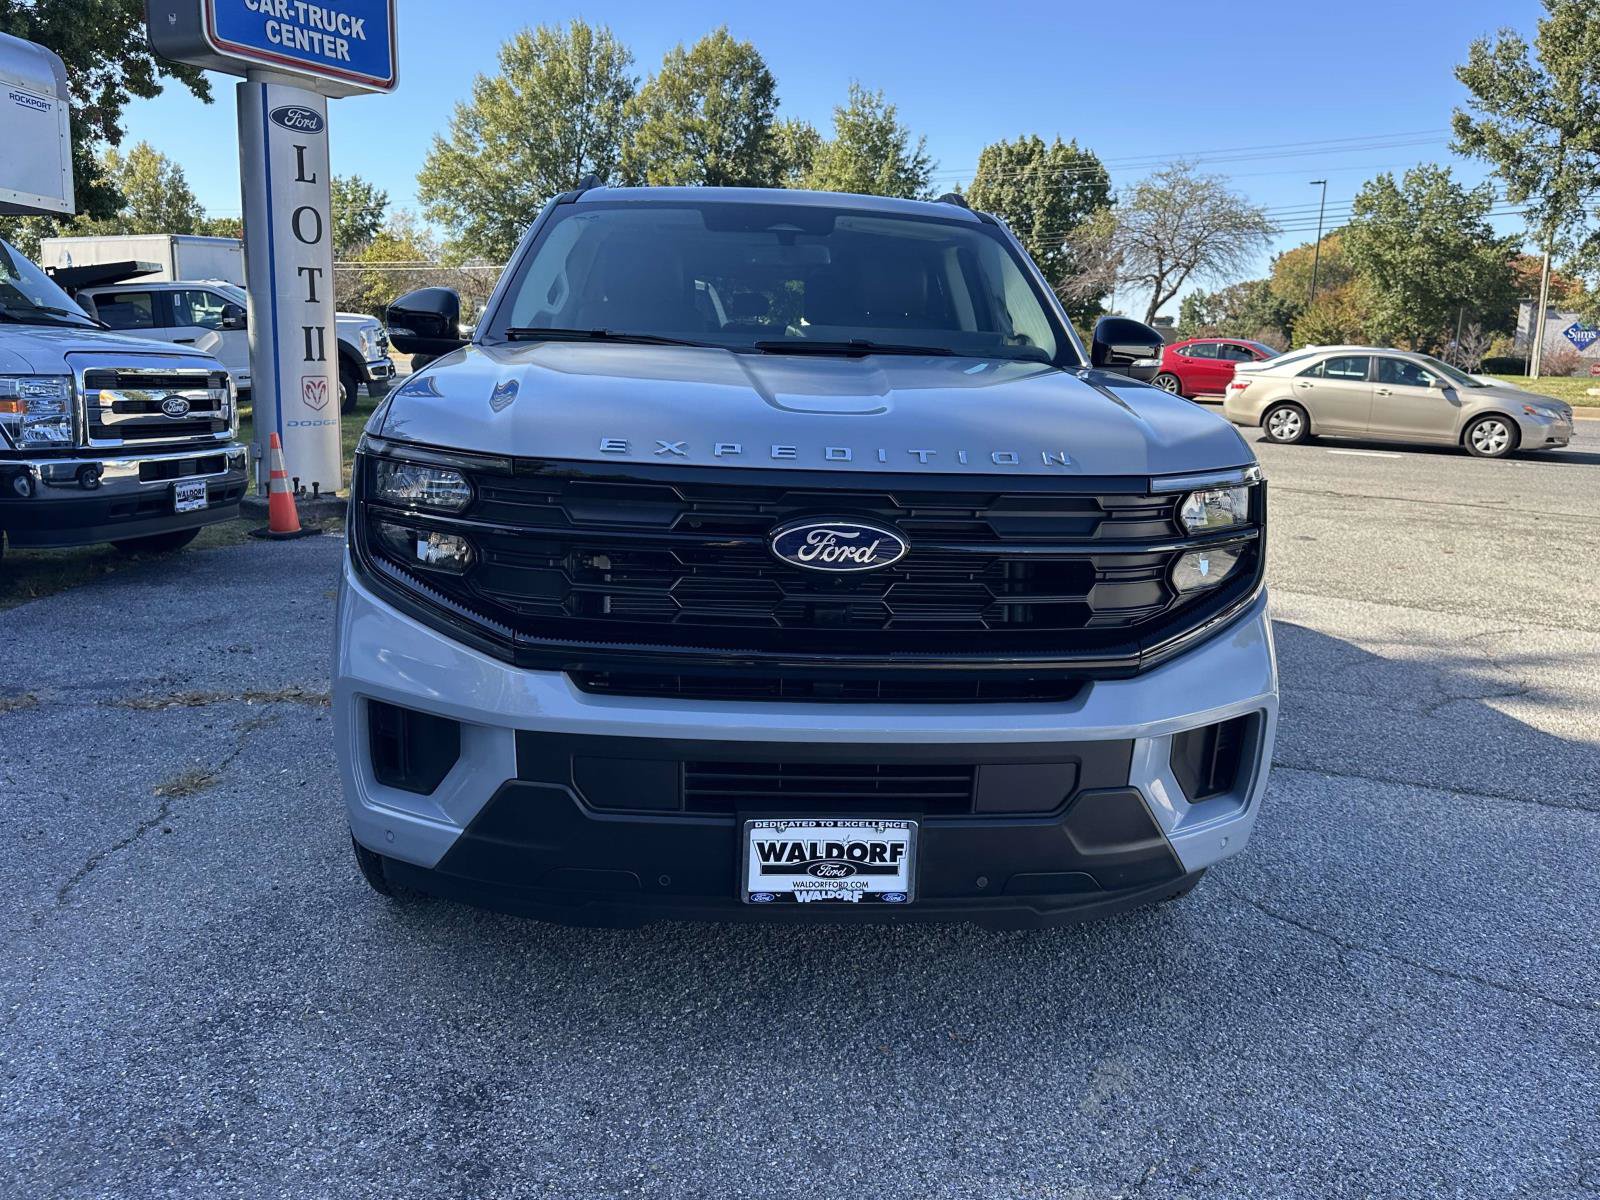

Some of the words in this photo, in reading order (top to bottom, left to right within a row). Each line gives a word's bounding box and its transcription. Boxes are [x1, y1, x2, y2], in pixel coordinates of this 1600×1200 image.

[265, 19, 351, 62] CENTER
[9, 92, 52, 110] ROCKPORT
[284, 107, 318, 130] Ford
[291, 144, 323, 303] LOT
[600, 437, 1072, 466] EXPEDITION
[176, 487, 205, 499] WALDORF
[798, 529, 880, 563] Ford
[837, 821, 908, 829] EXCELLENCE
[754, 841, 907, 863] WALDORF
[816, 863, 847, 878] Ford
[792, 881, 869, 889] WALDORFFORD.COM
[793, 890, 863, 903] WALDORF
